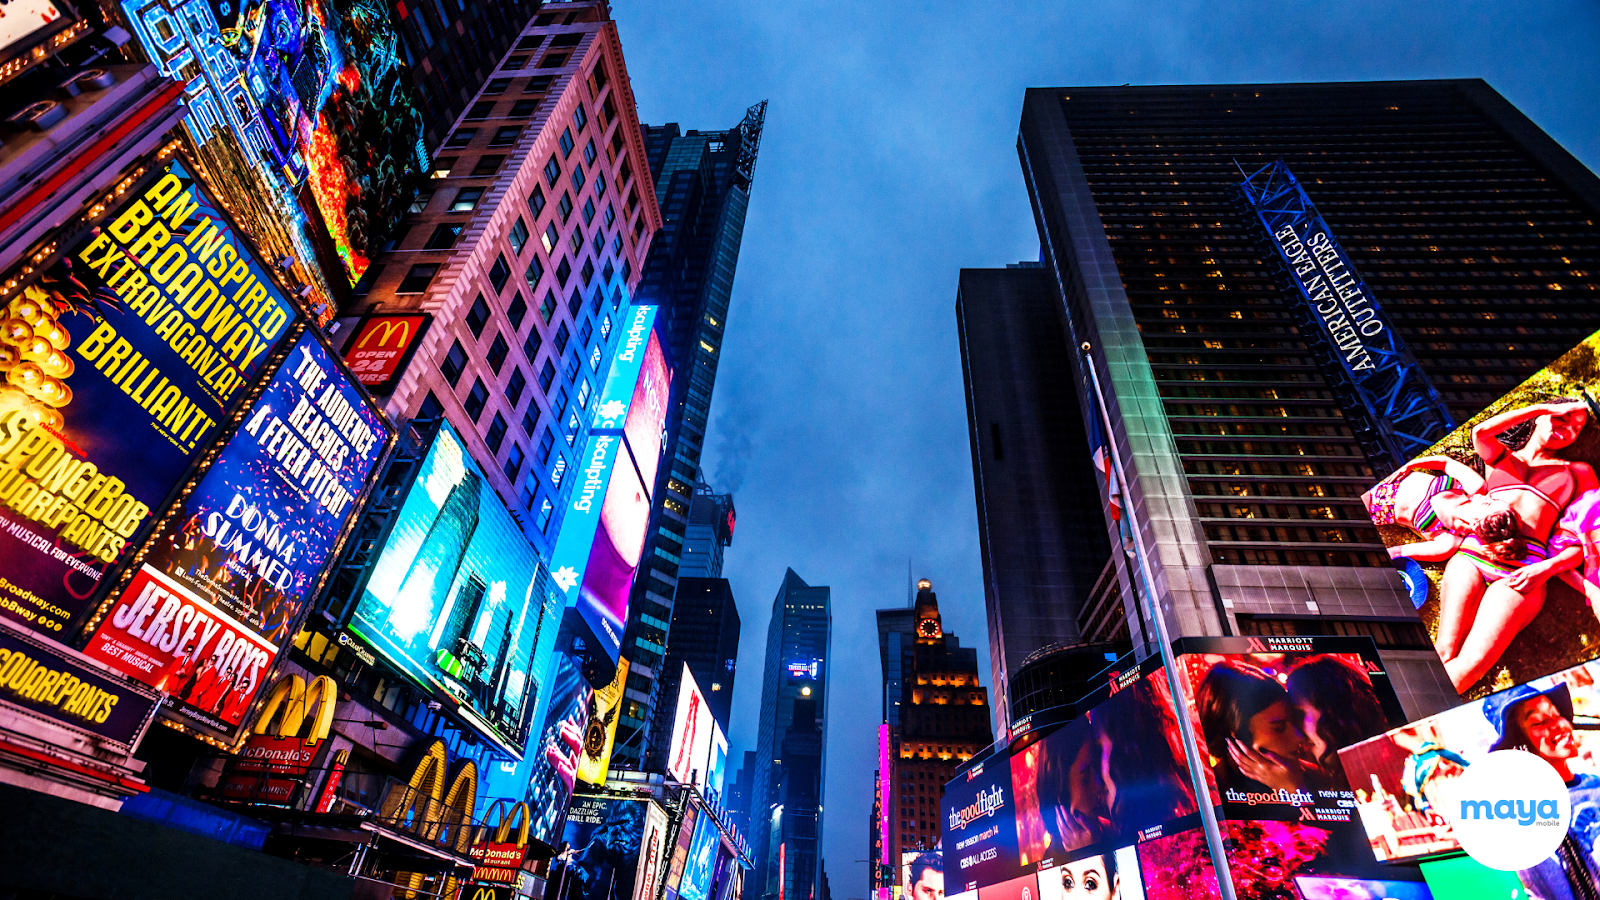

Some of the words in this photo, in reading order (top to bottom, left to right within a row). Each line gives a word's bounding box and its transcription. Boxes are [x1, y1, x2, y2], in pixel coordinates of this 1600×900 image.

[1275, 224, 1316, 278] EAGLE
[108, 199, 267, 373] BROADWAY
[183, 218, 289, 341] INSPIRED
[1306, 232, 1383, 337] OUTFITTERS
[1302, 274, 1375, 371] AMERICAN
[293, 345, 327, 399] THE
[352, 360, 387, 371] 24
[38, 421, 88, 459] nickelodeon
[150, 421, 160, 431] THE
[158, 428, 169, 438] NEW
[245, 404, 272, 437] A
[287, 396, 349, 472] REACHES
[316, 383, 378, 461] AUDIENCE
[0, 409, 149, 538] SPONGEBOB
[258, 416, 311, 480] FEVER
[225, 493, 296, 565] DONNA
[267, 508, 280, 522] THE
[6, 521, 53, 555] MUSICAL
[50, 547, 67, 562] FOR
[65, 555, 103, 581] EVERYONE
[201, 511, 293, 595] SUMMER
[226, 559, 254, 583] MUSICAL
[100, 642, 126, 661] BEST
[122, 653, 155, 674] MUSICAL
[113, 580, 221, 663] JERSEY
[214, 628, 269, 696] BOYS
[1119, 665, 1141, 682] MARRIOTT
[1120, 673, 1140, 689] MARQUIS
[570, 807, 599, 816] DAZZLING
[1318, 790, 1338, 798] new
[875, 840, 882, 848] &
[955, 841, 965, 850] new
[965, 835, 979, 847] season
[979, 827, 993, 841] march
[993, 825, 999, 835] 14
